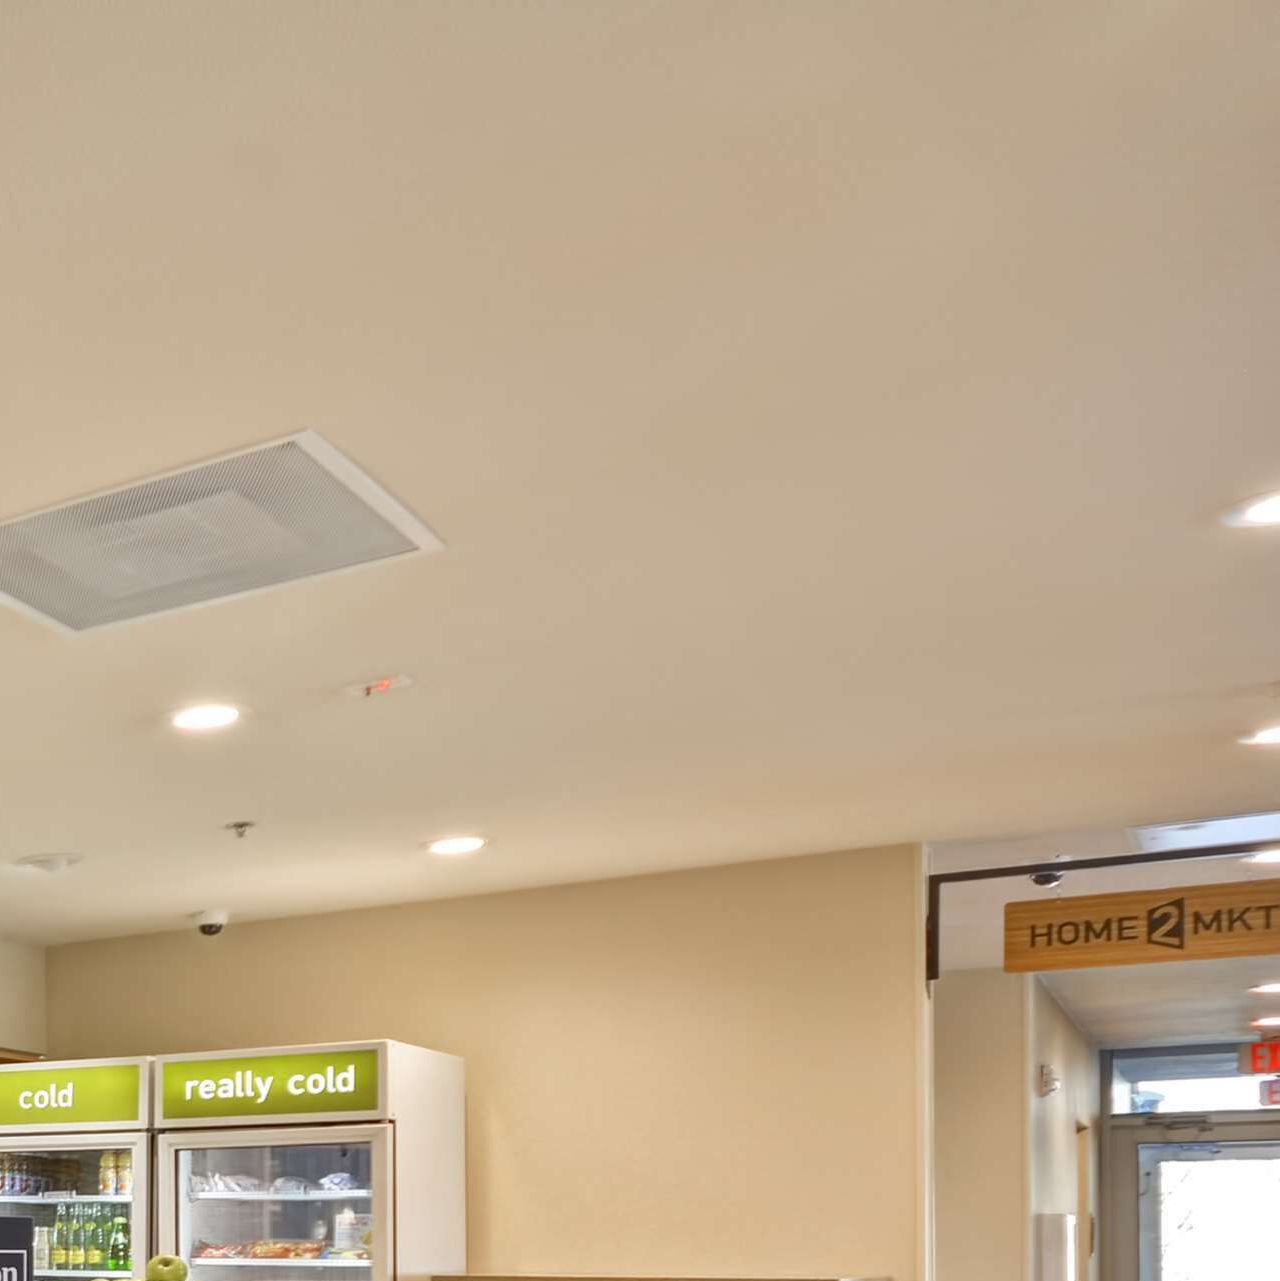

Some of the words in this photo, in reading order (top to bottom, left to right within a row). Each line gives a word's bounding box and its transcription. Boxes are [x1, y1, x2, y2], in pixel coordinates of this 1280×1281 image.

[18, 1082, 74, 1109] cold
[184, 1068, 274, 1104] really
[287, 1064, 356, 1096] cold
